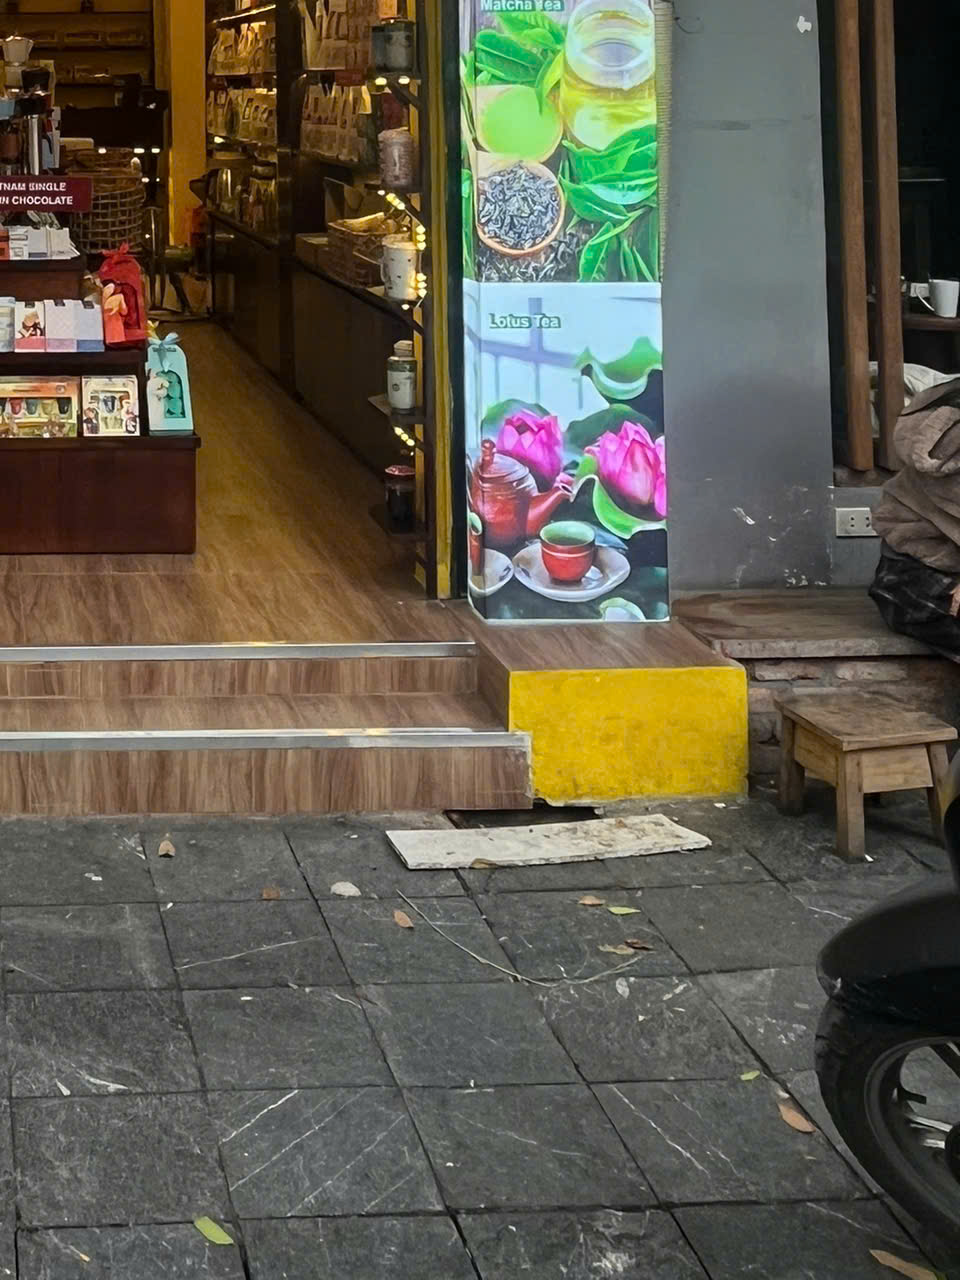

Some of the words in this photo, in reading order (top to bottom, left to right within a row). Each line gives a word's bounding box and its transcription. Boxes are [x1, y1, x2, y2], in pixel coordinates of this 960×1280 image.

[28, 182, 67, 192] SINGLE
[11, 196, 74, 206] CHOCOLATE
[488, 313, 531, 328] Lotus
[534, 313, 561, 328] Tea
